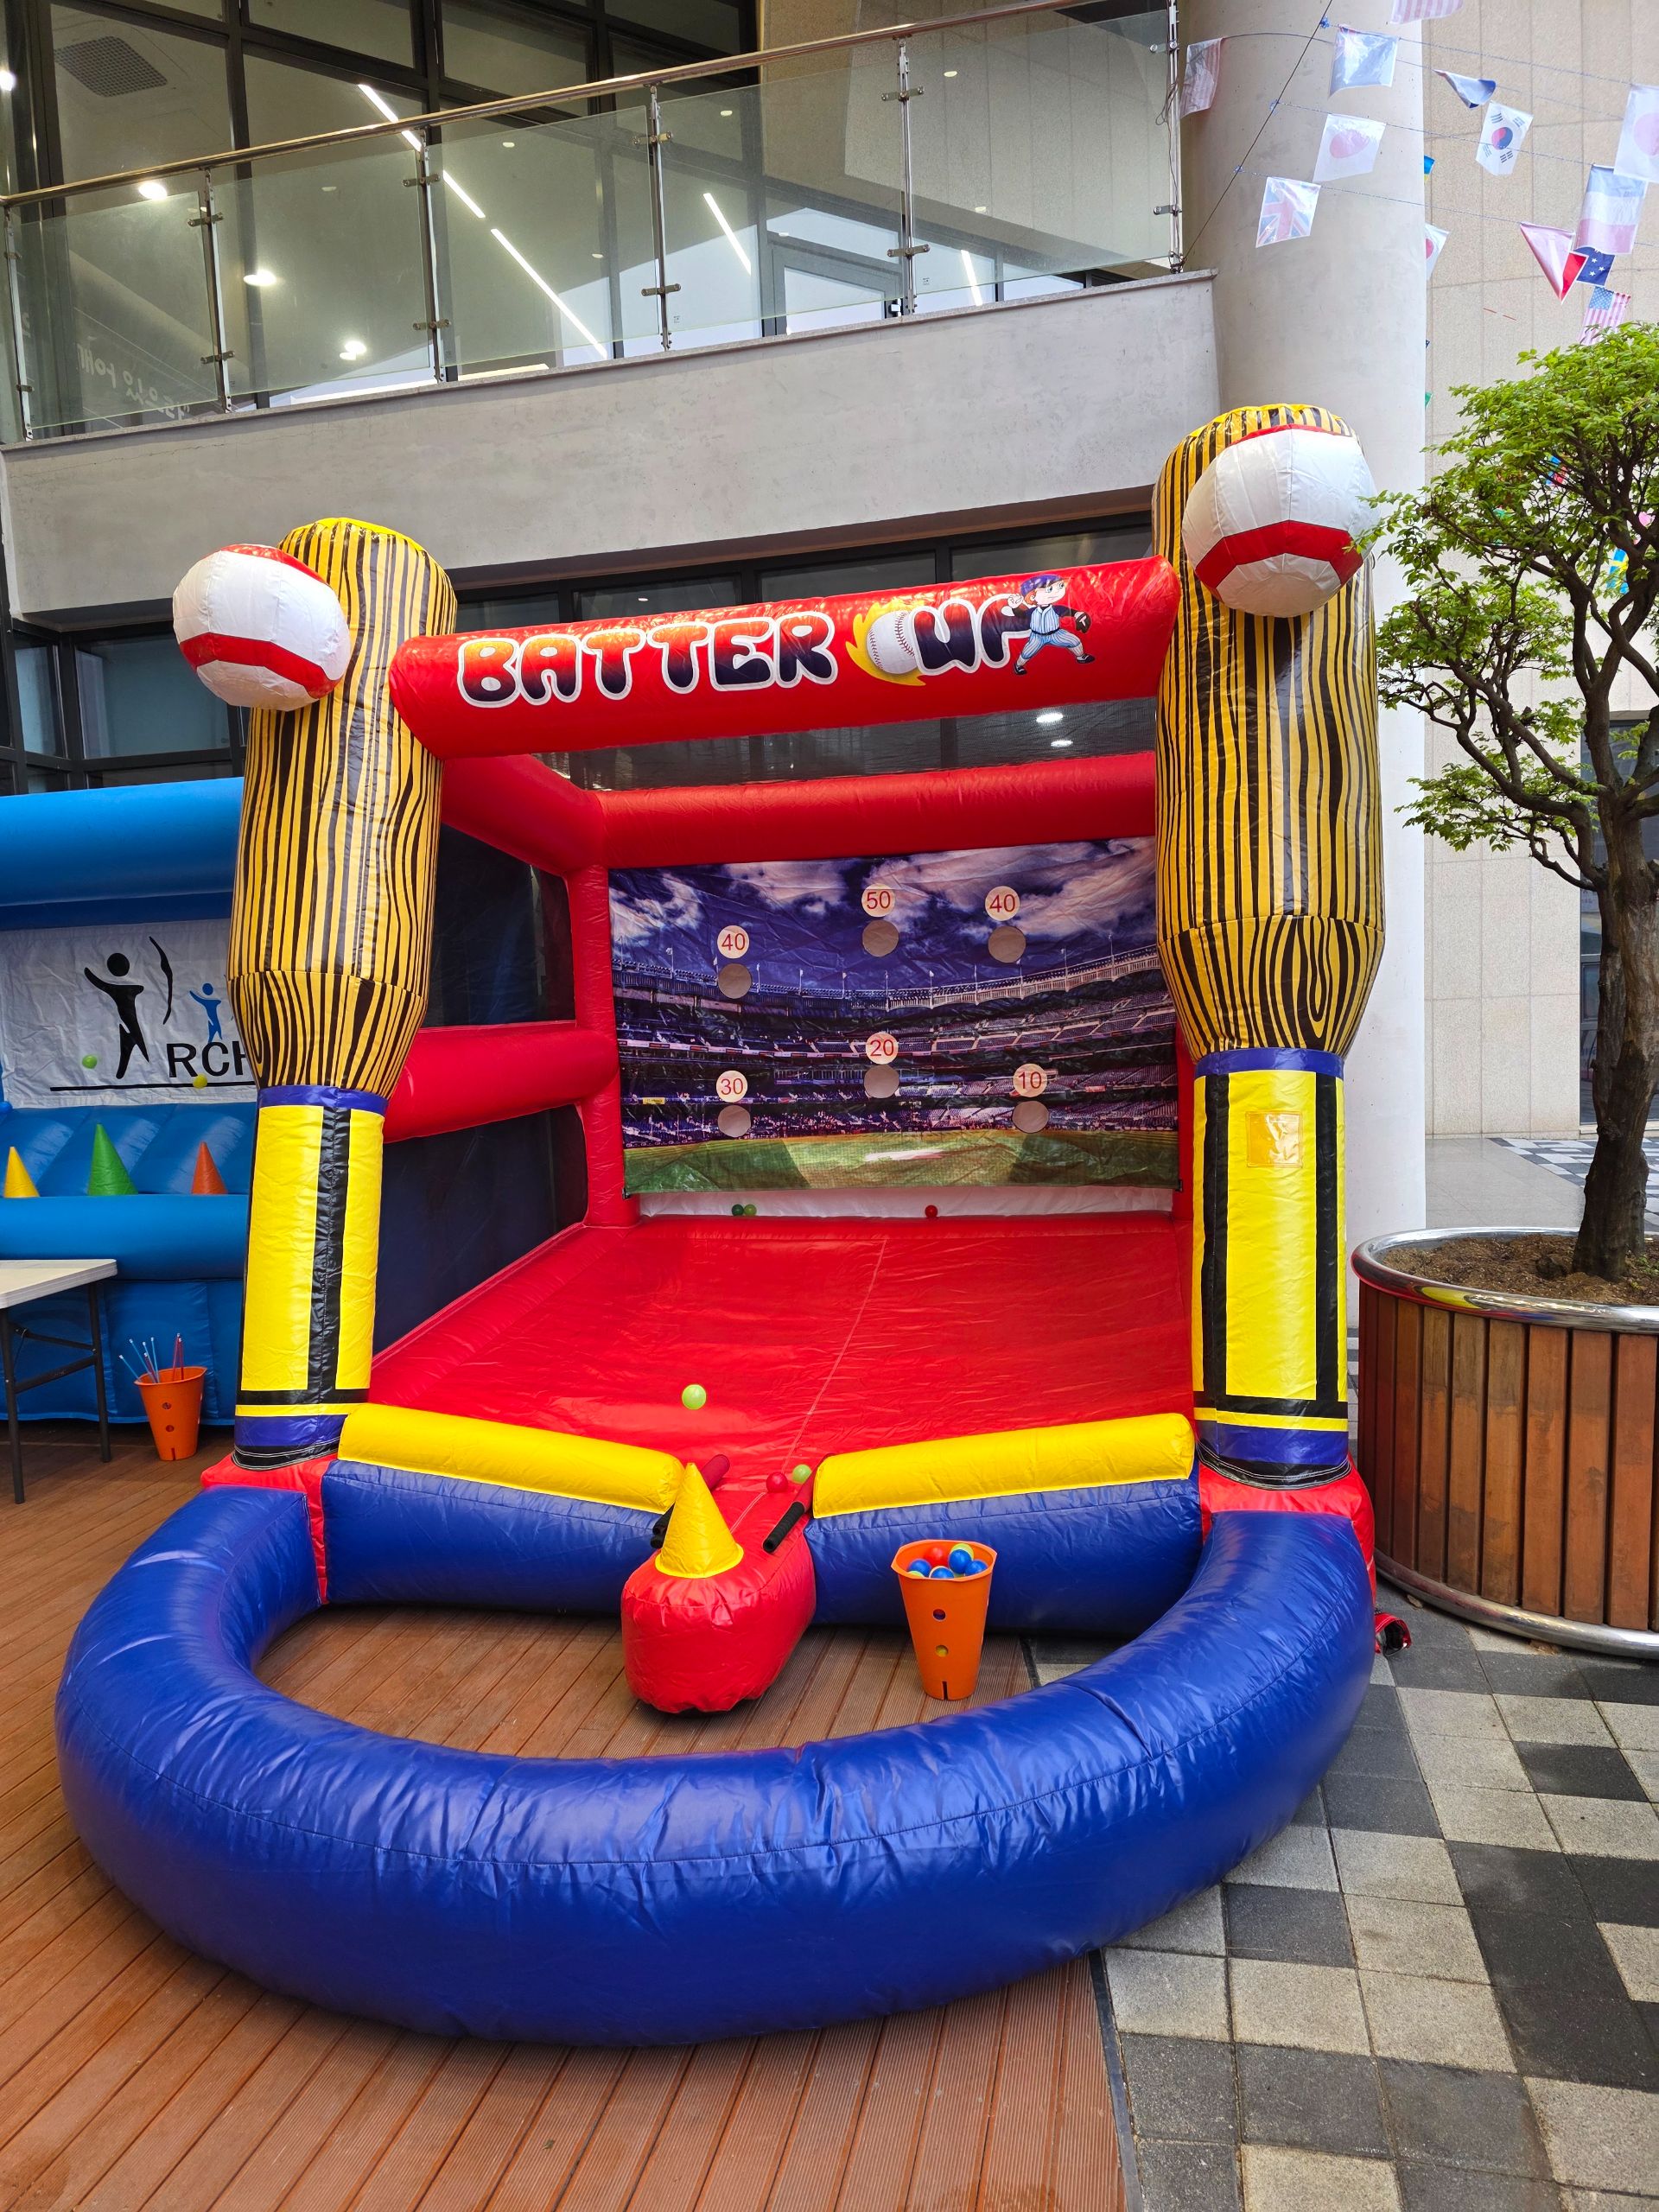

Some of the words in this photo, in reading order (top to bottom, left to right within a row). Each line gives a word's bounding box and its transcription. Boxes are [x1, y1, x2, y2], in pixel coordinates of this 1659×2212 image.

[457, 612, 838, 709] BATTER
[912, 596, 1030, 674] UP
[865, 890, 892, 911] 50
[988, 893, 1016, 913] 40
[721, 932, 747, 951] 40
[869, 1038, 895, 1058] 20
[720, 1077, 744, 1096] 30
[1018, 1071, 1042, 1090] 10
